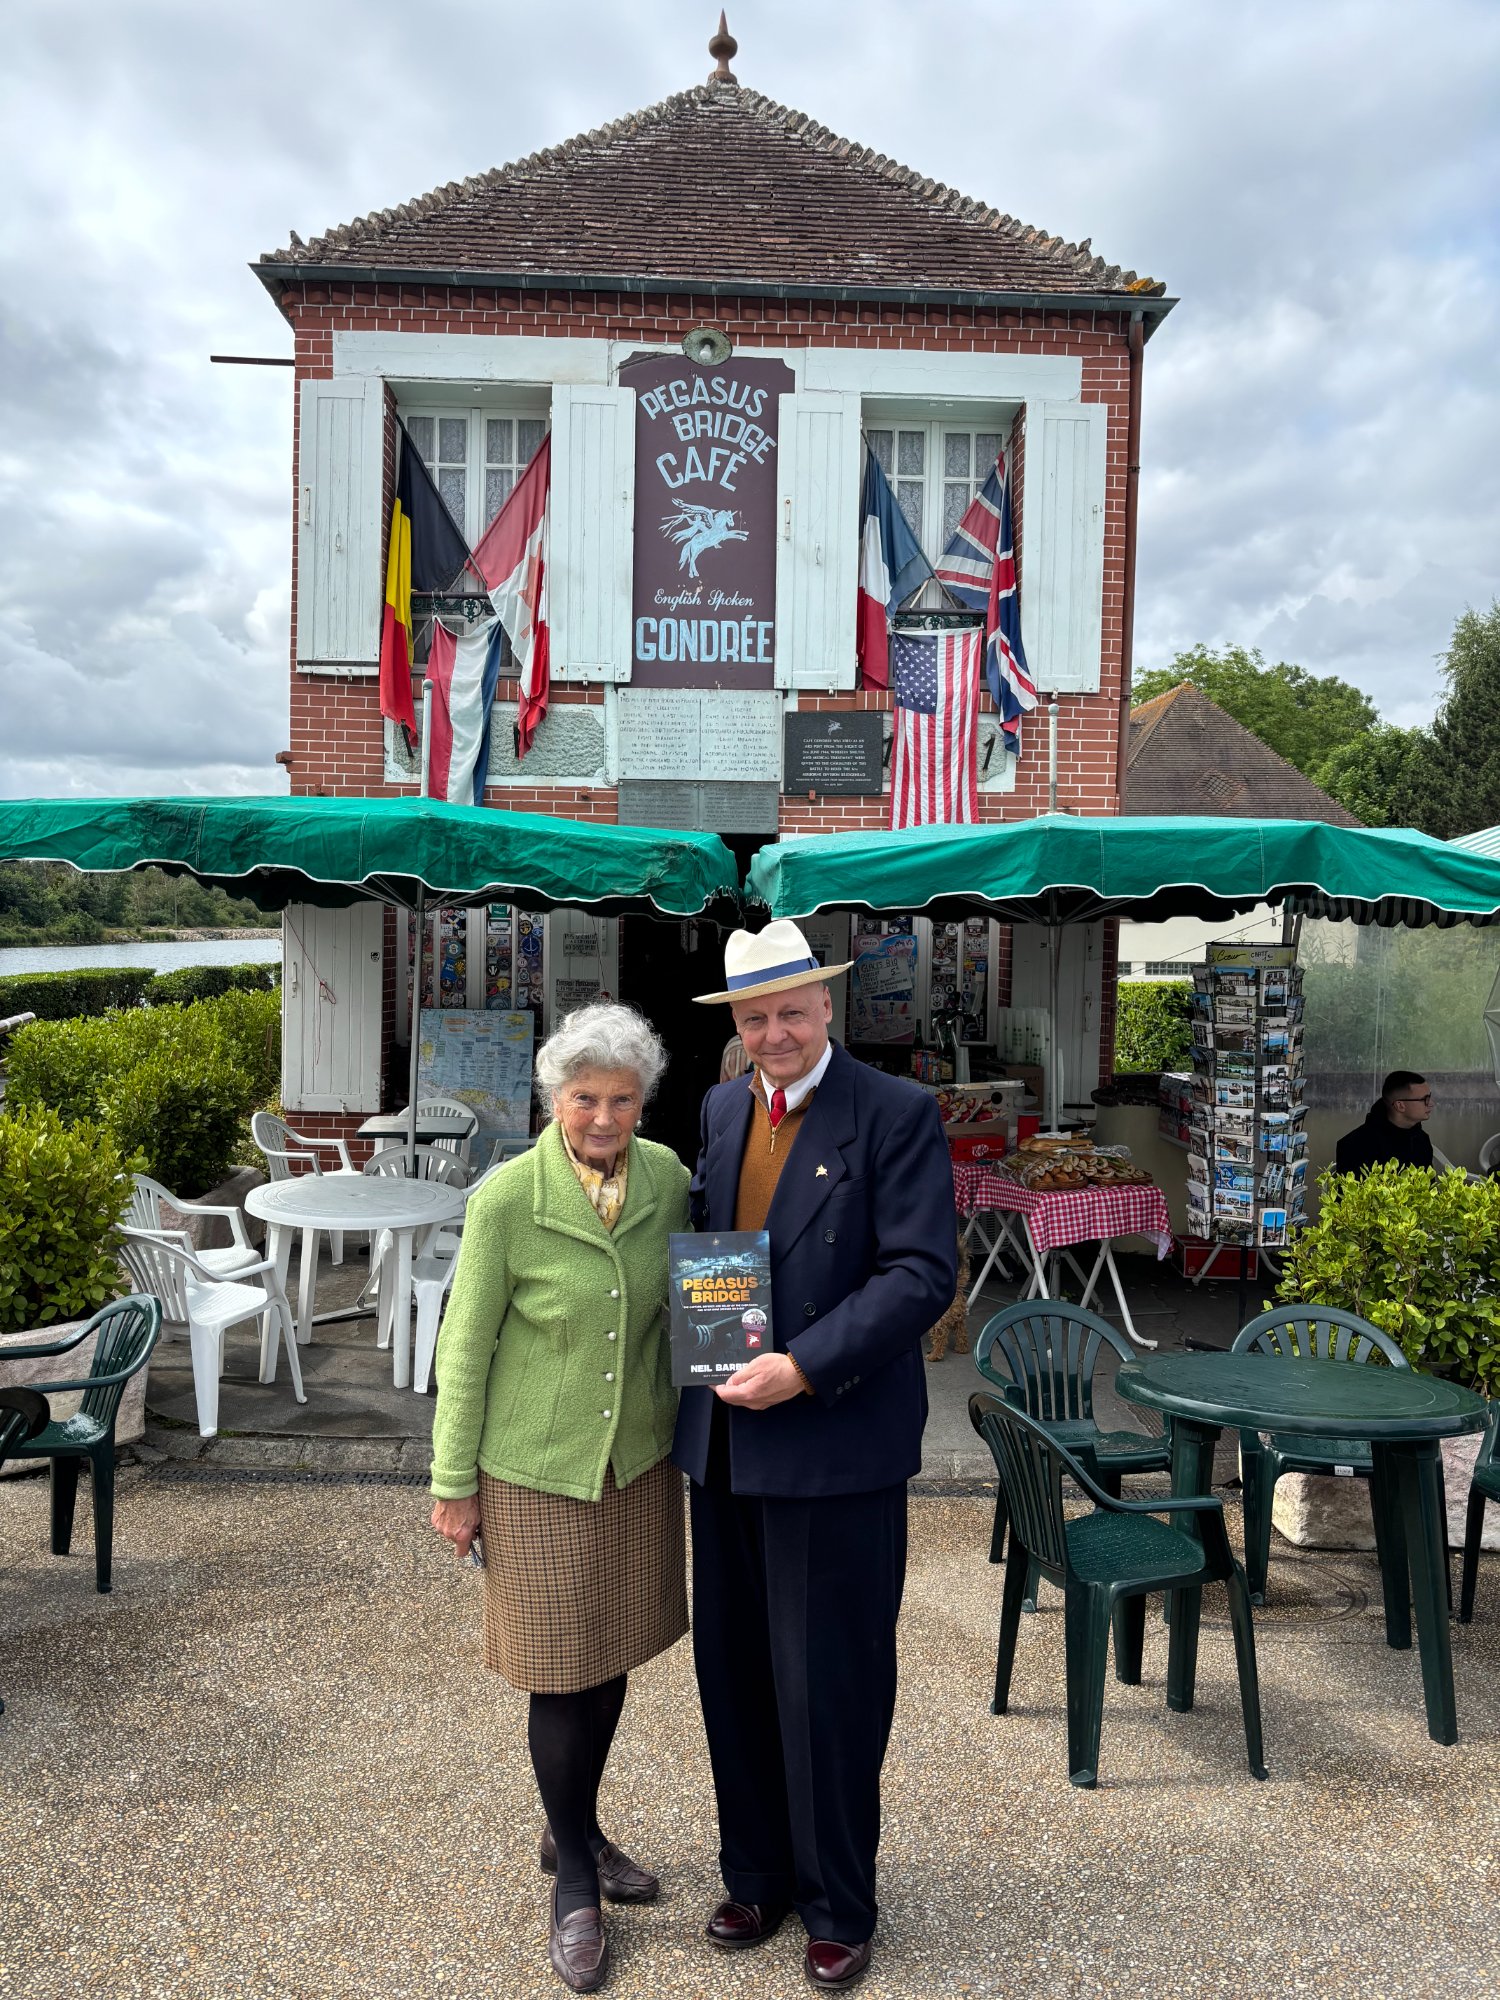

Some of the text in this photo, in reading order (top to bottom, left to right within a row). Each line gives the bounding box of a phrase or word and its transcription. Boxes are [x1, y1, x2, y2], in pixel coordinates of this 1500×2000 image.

[639, 376, 768, 420] PEGASUS
[671, 410, 777, 465] BRIDGE
[656, 446, 747, 492] CAFÉ
[654, 588, 754, 611] English Spoken
[636, 614, 774, 663] GONDRÉE
[682, 1276, 758, 1291] PEGASUS
[691, 1290, 751, 1303] BRIDGE
[690, 1363, 748, 1373] NEIL BARBE
